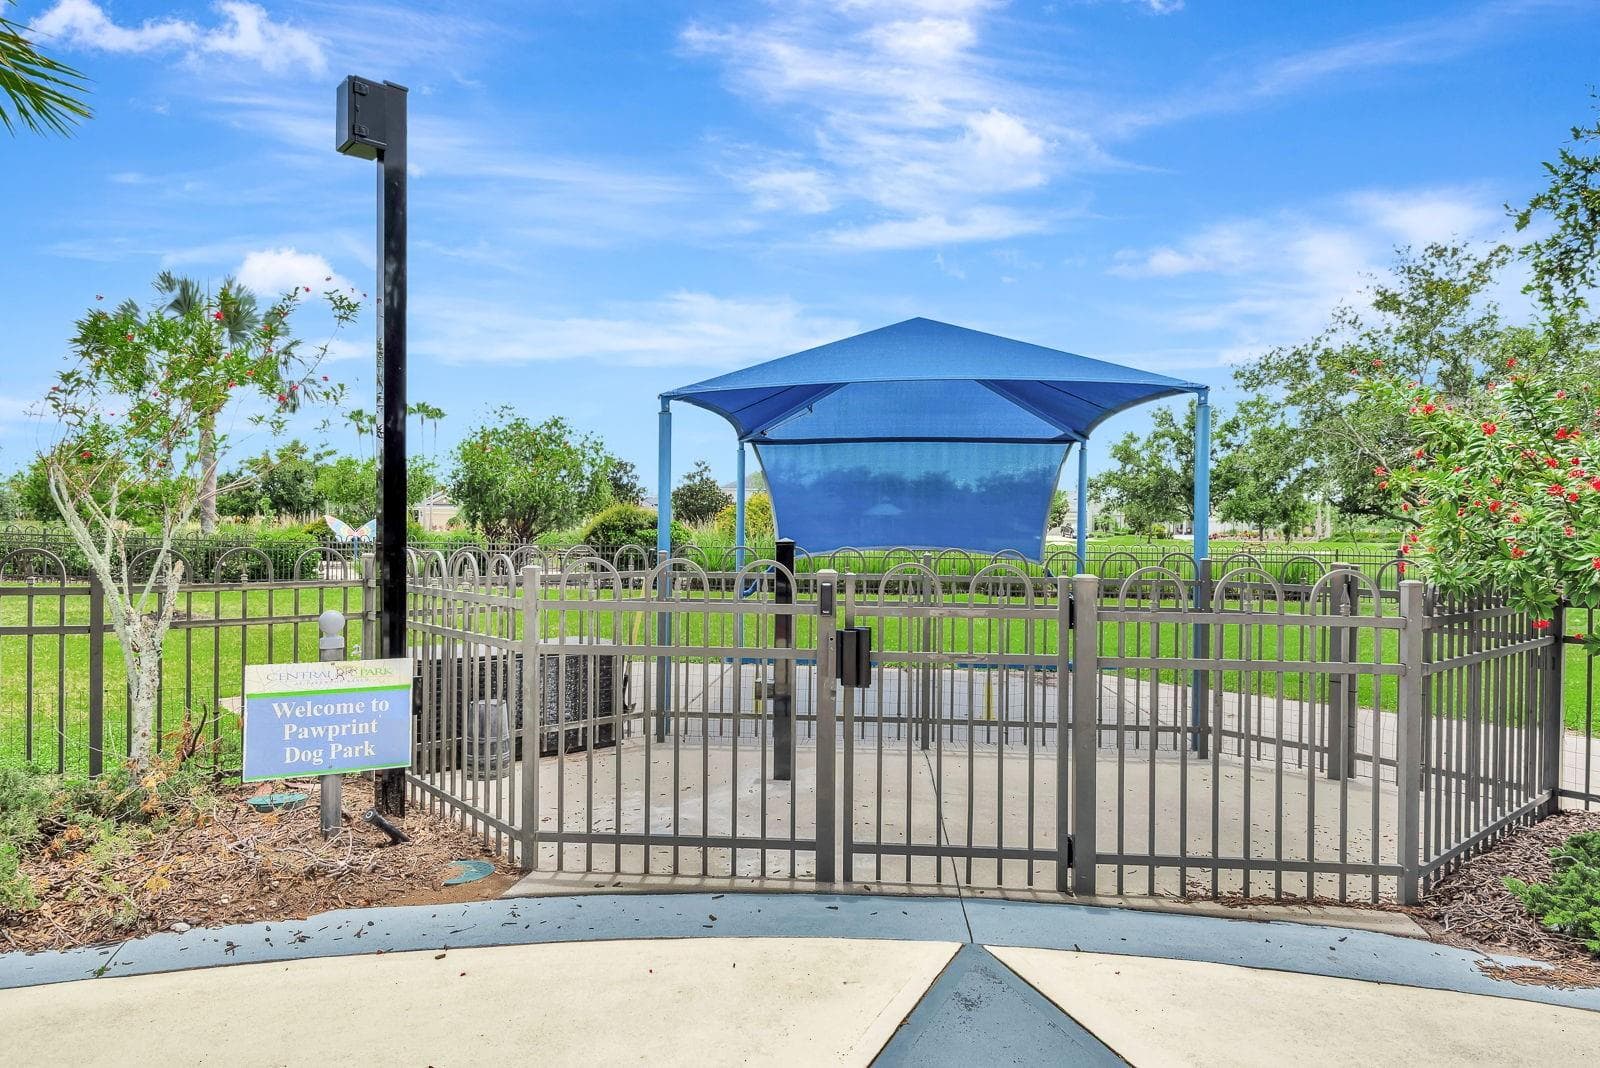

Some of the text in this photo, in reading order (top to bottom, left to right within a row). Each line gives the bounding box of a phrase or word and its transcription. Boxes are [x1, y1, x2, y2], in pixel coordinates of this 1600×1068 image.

[266, 667, 393, 681] CENTRAL PARK
[272, 698, 390, 719] Welcome to
[283, 718, 379, 742] Pawprint
[284, 741, 377, 766] Dog Park
